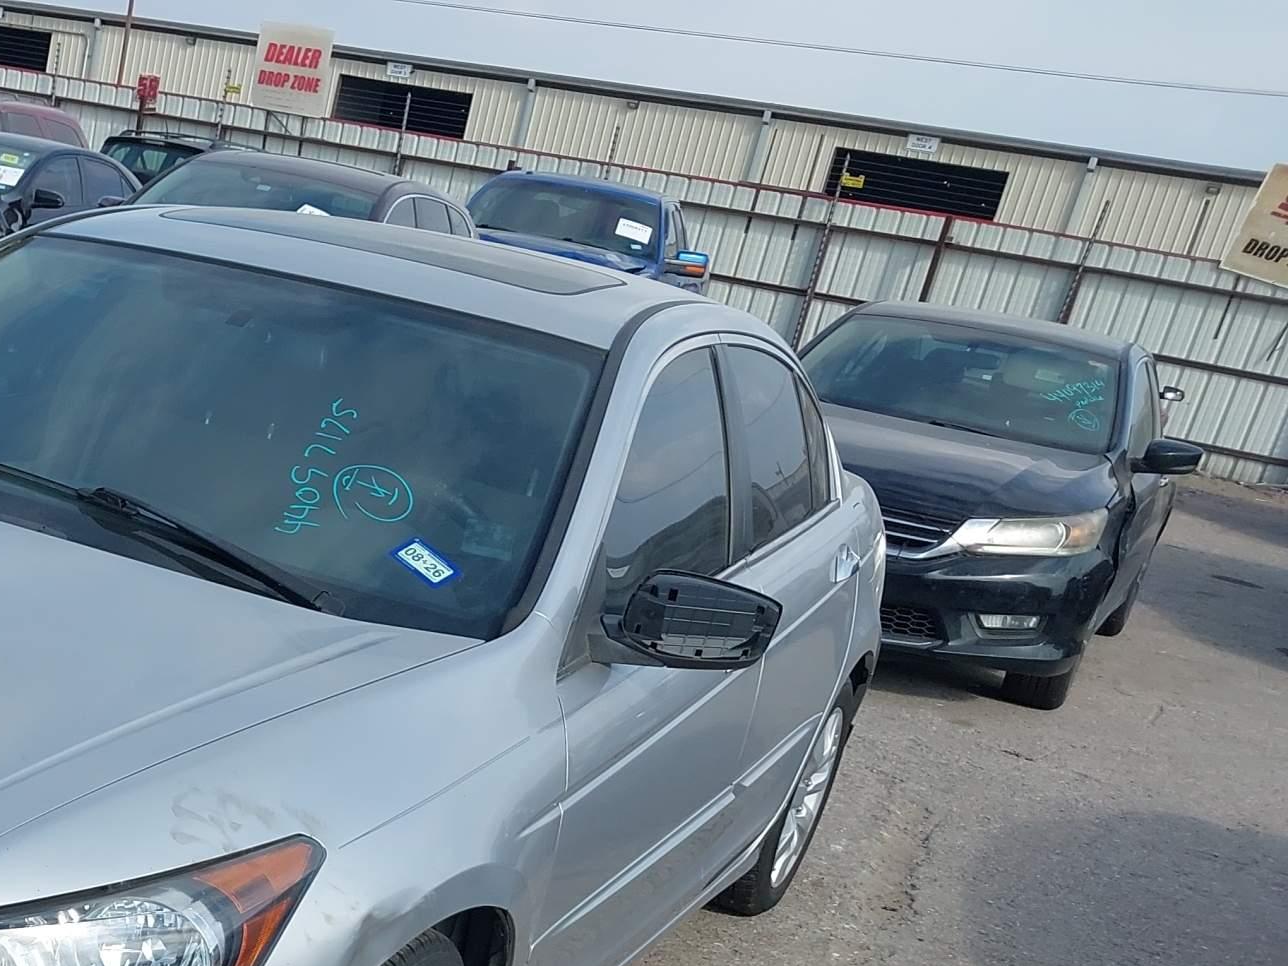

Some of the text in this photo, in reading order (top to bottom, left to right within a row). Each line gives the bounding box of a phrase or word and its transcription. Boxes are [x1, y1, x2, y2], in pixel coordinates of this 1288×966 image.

[263, 42, 322, 69] DEALER
[257, 69, 321, 94] DROP ZONE
